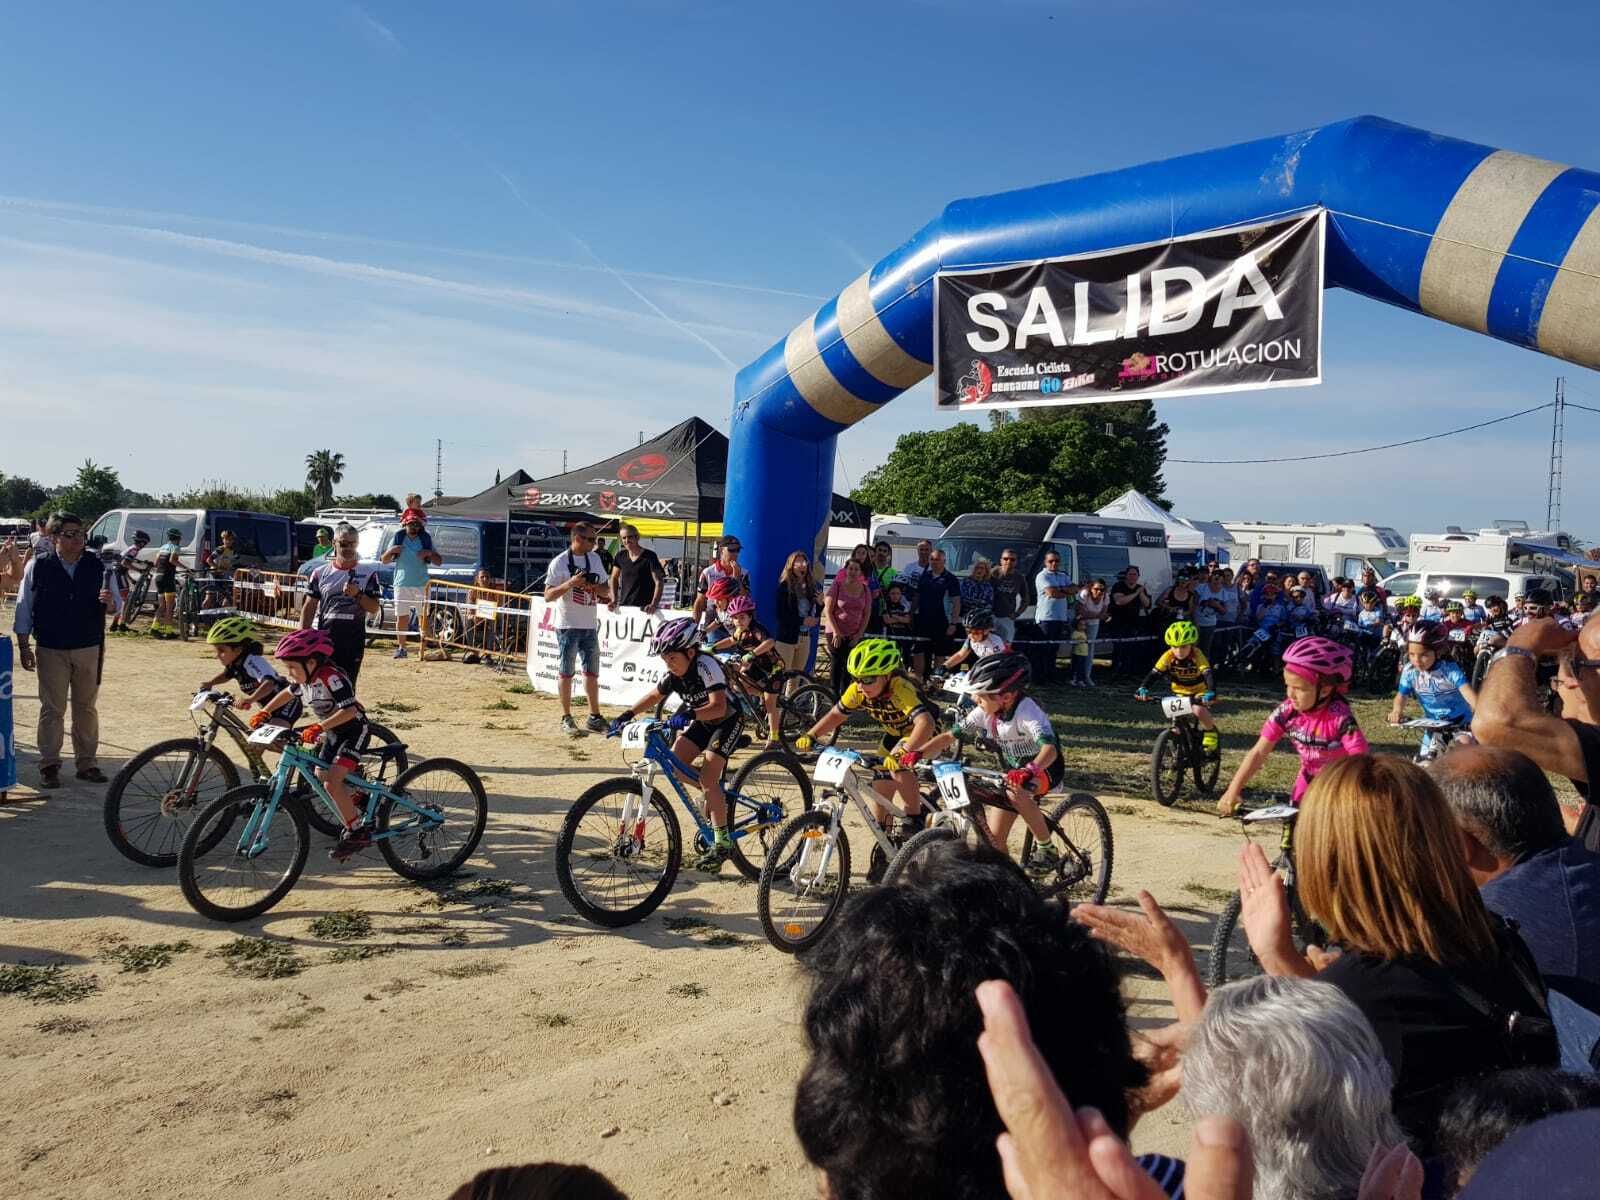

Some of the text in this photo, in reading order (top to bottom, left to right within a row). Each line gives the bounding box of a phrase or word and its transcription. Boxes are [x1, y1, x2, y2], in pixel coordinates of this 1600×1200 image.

[966, 254, 1284, 353] SALIDA
[1156, 338, 1301, 374] ROTULACION
[997, 362, 1071, 377] Escuela Ciclista
[540, 493, 592, 507] 24MX
[617, 496, 675, 516] 24MX
[832, 510, 855, 524] MX
[1170, 698, 1185, 713] 62
[627, 725, 639, 742] 64
[938, 777, 961, 801] 146
